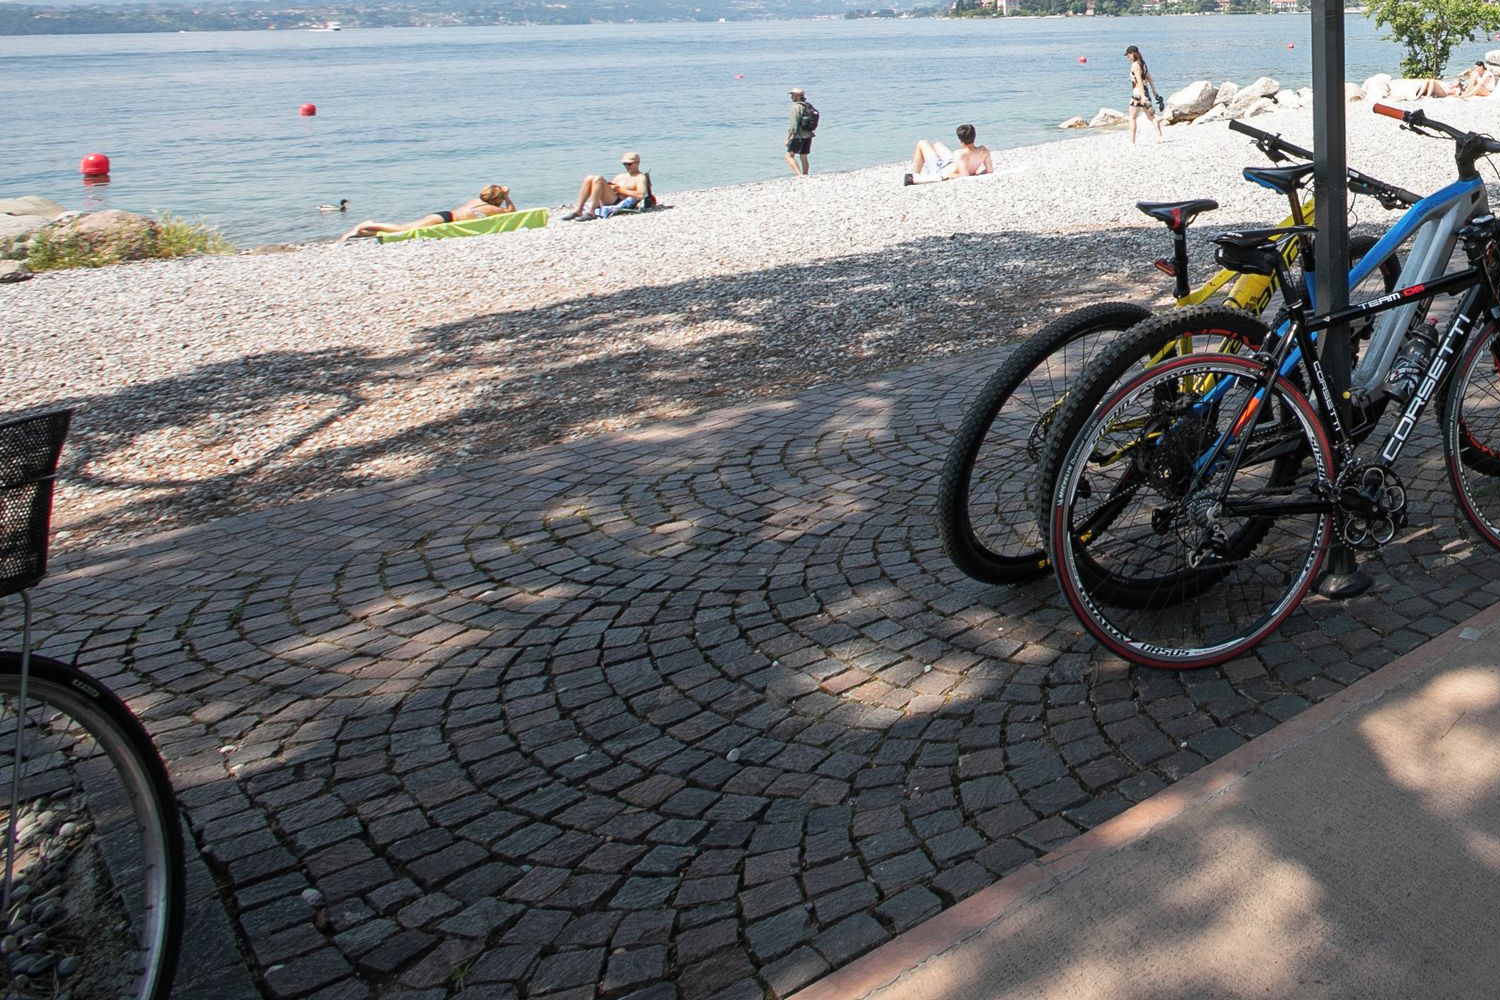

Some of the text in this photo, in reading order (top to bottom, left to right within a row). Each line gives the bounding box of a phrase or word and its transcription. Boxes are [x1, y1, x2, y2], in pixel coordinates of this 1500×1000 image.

[1358, 292, 1400, 310] TEAM
[1313, 361, 1341, 431] CORSETTI
[1382, 313, 1470, 461] CORSETTI
